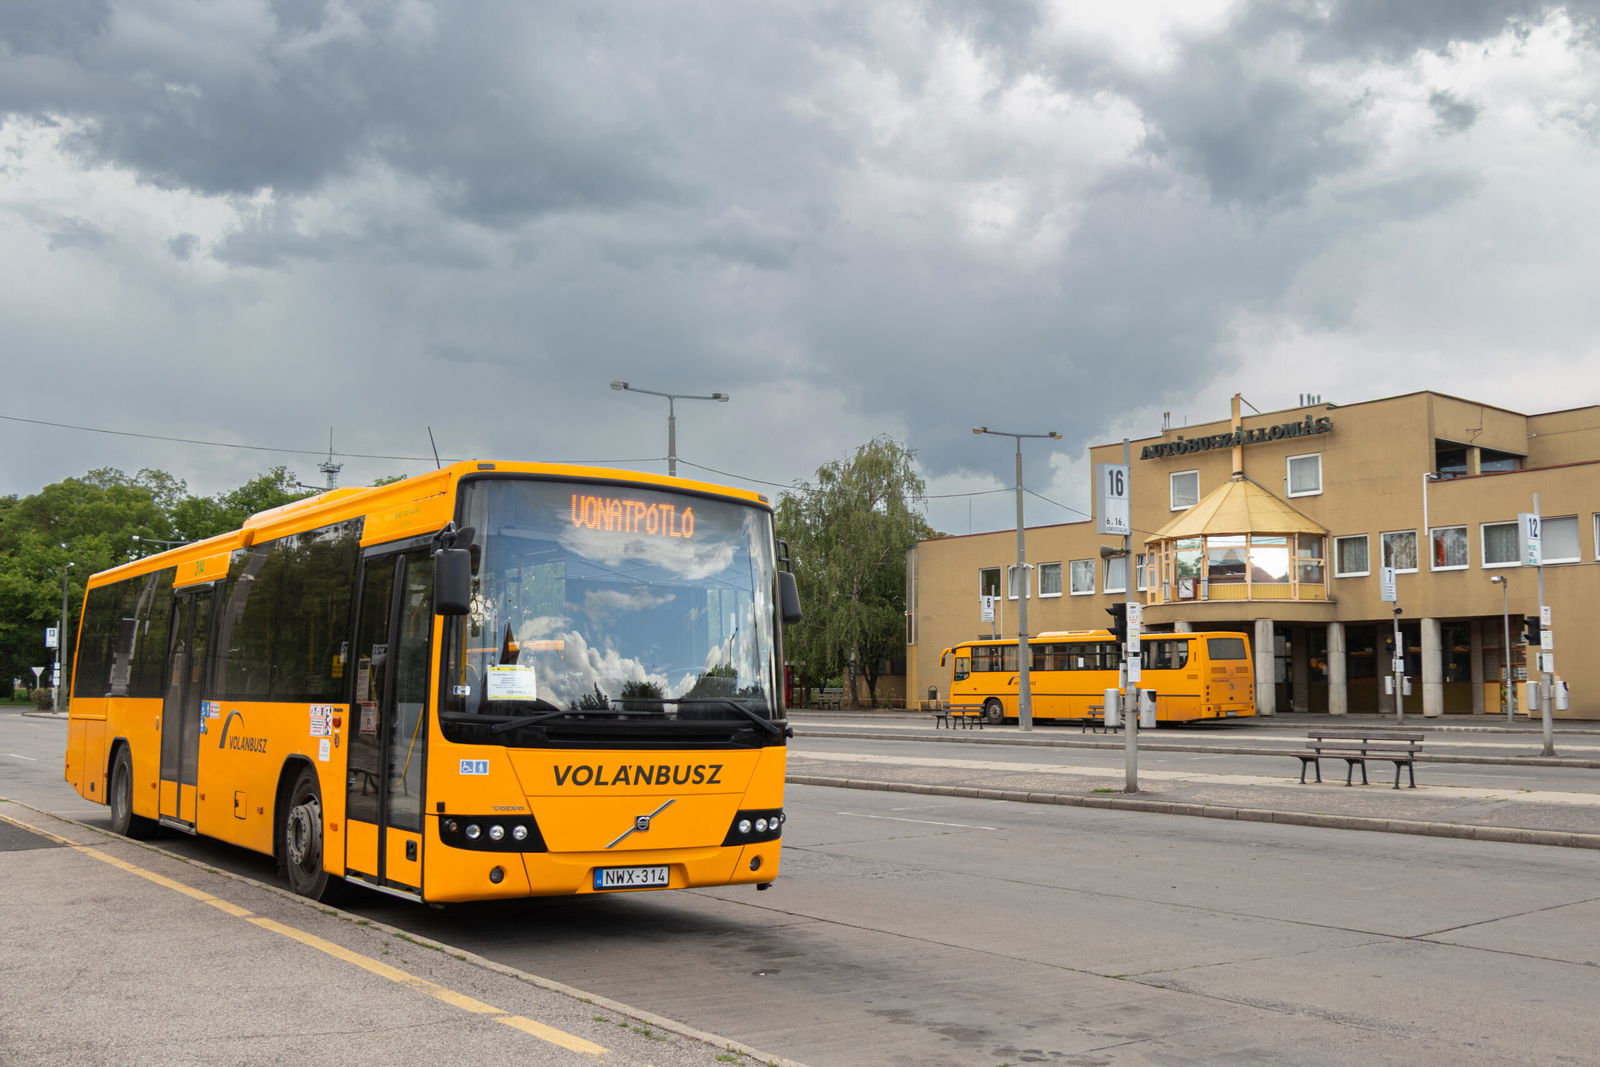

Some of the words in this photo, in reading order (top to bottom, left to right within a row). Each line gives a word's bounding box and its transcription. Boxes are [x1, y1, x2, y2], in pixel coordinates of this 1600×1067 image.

[1140, 414, 1333, 460] AUTÓBUSZÁLLOMÁS
[1108, 469, 1124, 497] 16
[571, 494, 694, 538] VONATPÓTLÓ
[1528, 517, 1538, 538] 12
[986, 597, 991, 608] 6
[49, 629, 56, 637] 13
[553, 764, 723, 786] VOLÁNBUSZ
[605, 868, 666, 884] NWX-314
